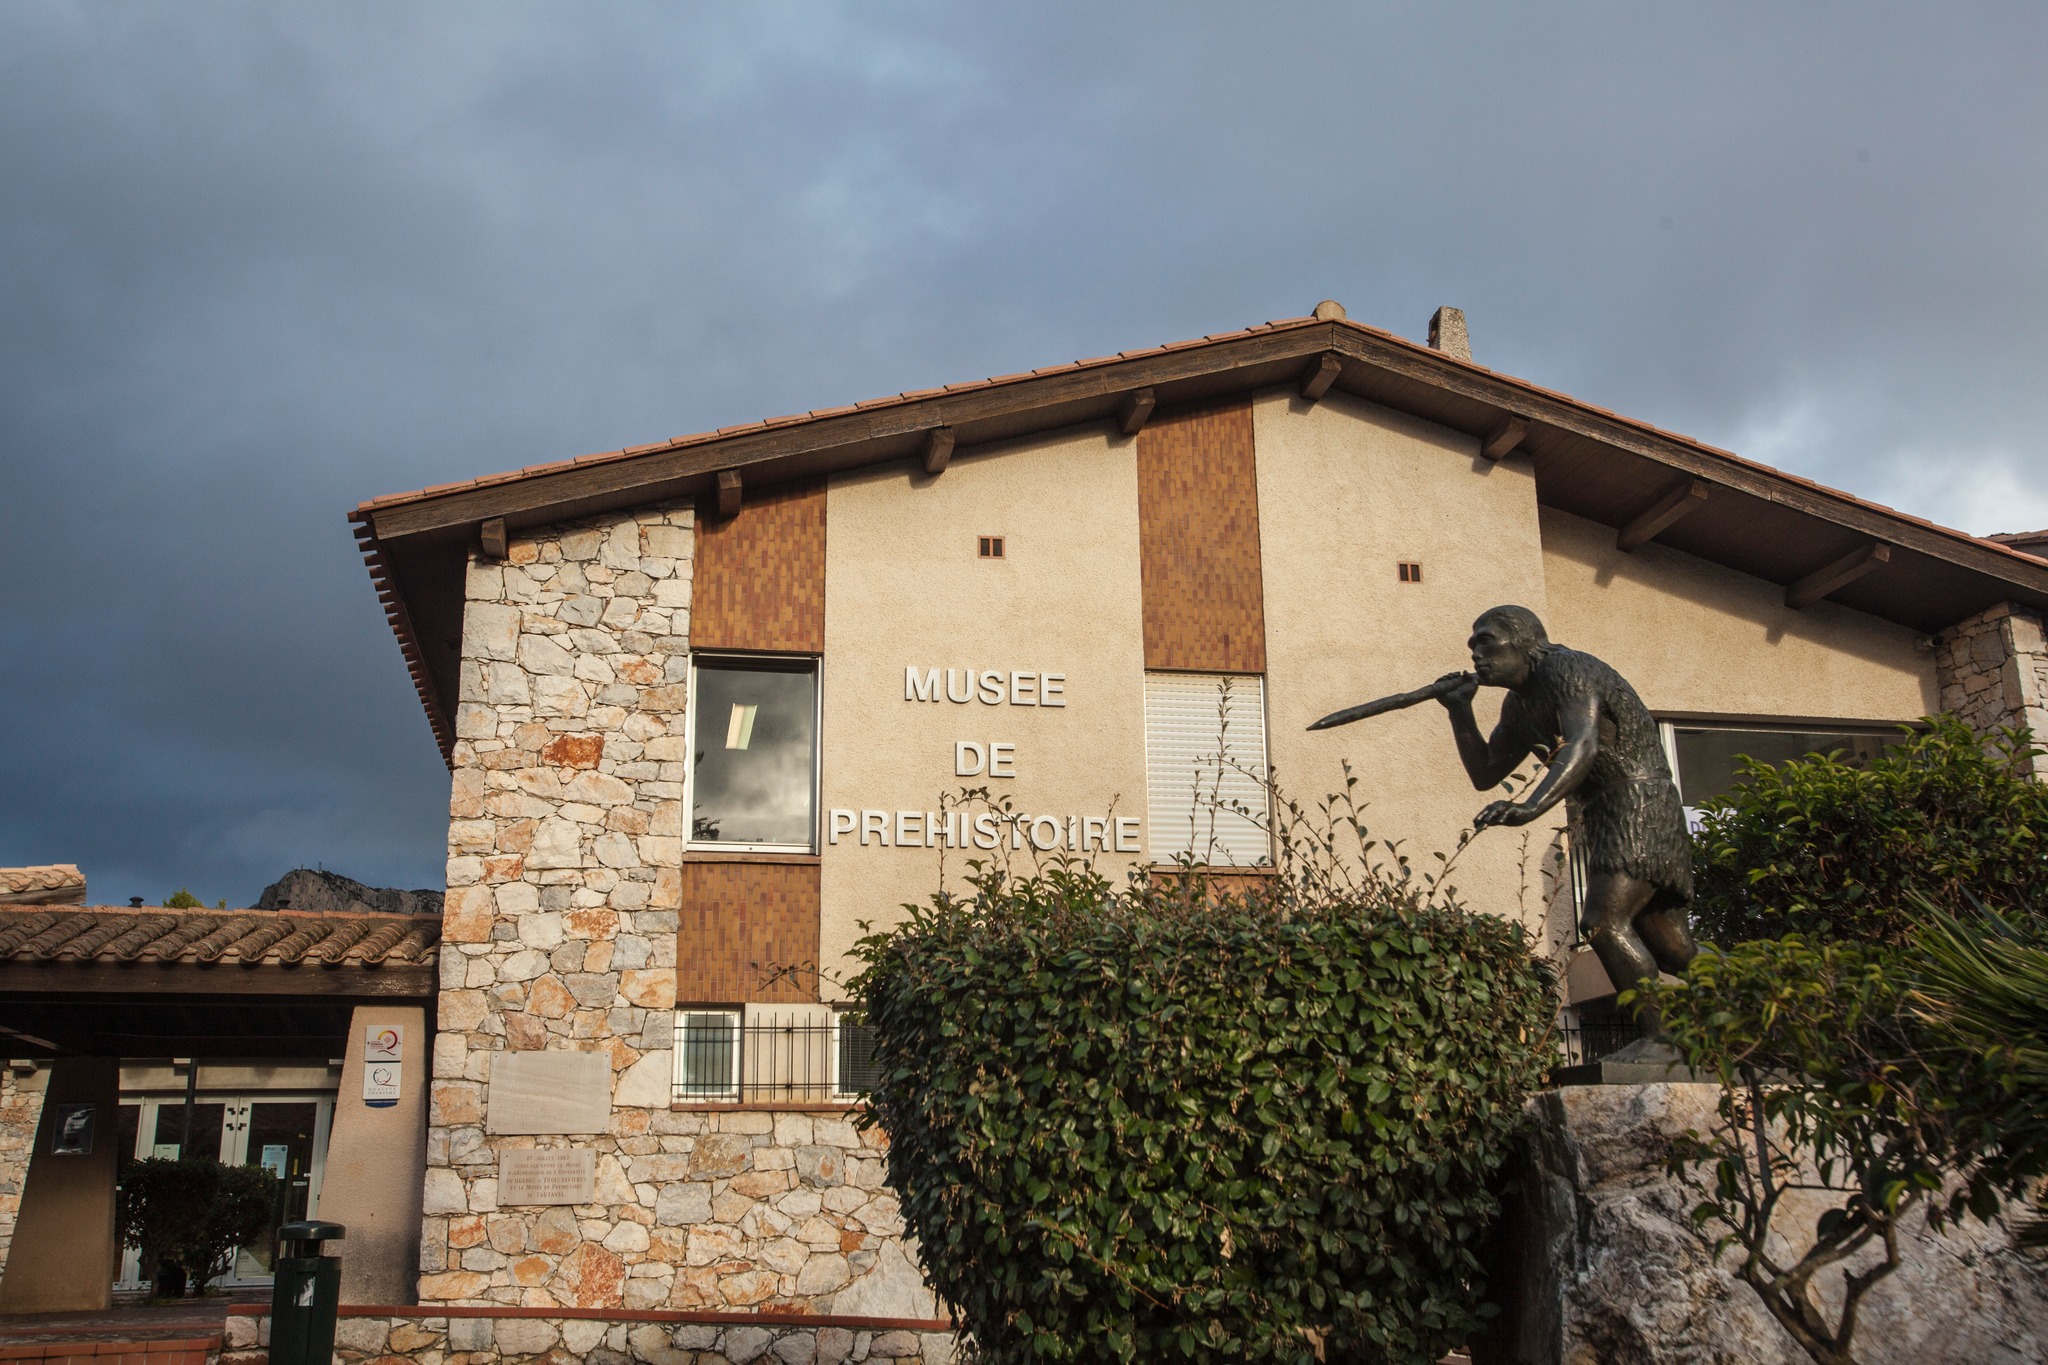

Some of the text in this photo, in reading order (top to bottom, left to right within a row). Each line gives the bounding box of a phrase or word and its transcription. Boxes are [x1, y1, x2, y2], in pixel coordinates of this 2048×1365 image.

[905, 666, 1066, 708] MUSEE
[956, 741, 1016, 778] DE
[829, 808, 1142, 852] PREHISTOIRE
